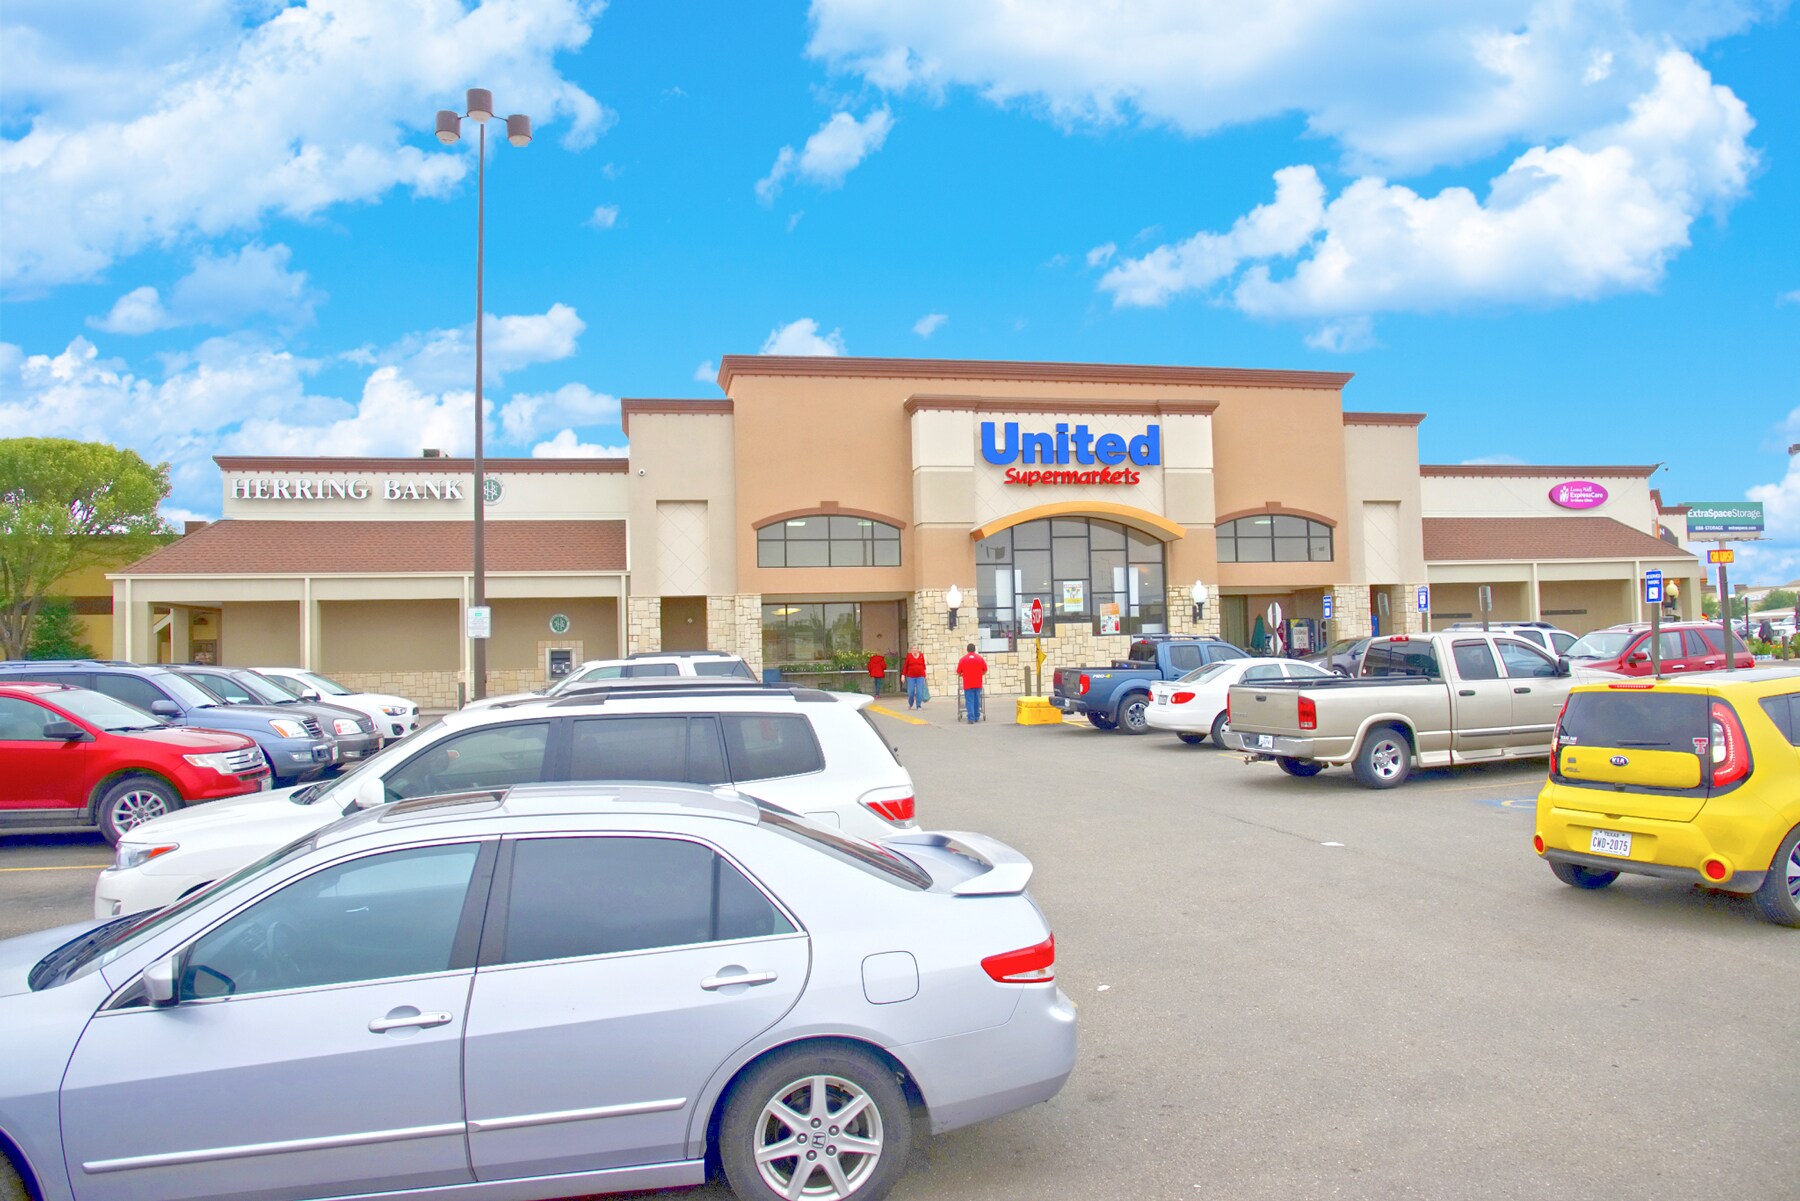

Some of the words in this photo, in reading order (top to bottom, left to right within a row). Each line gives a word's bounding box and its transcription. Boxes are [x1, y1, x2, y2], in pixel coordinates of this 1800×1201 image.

[981, 421, 1160, 466] United
[1004, 466, 1140, 487] Supermarkets
[230, 479, 369, 500] HERRING
[383, 480, 464, 500] BANK
[1032, 608, 1041, 623] STOP
[1592, 836, 1628, 851] CWD-2075
